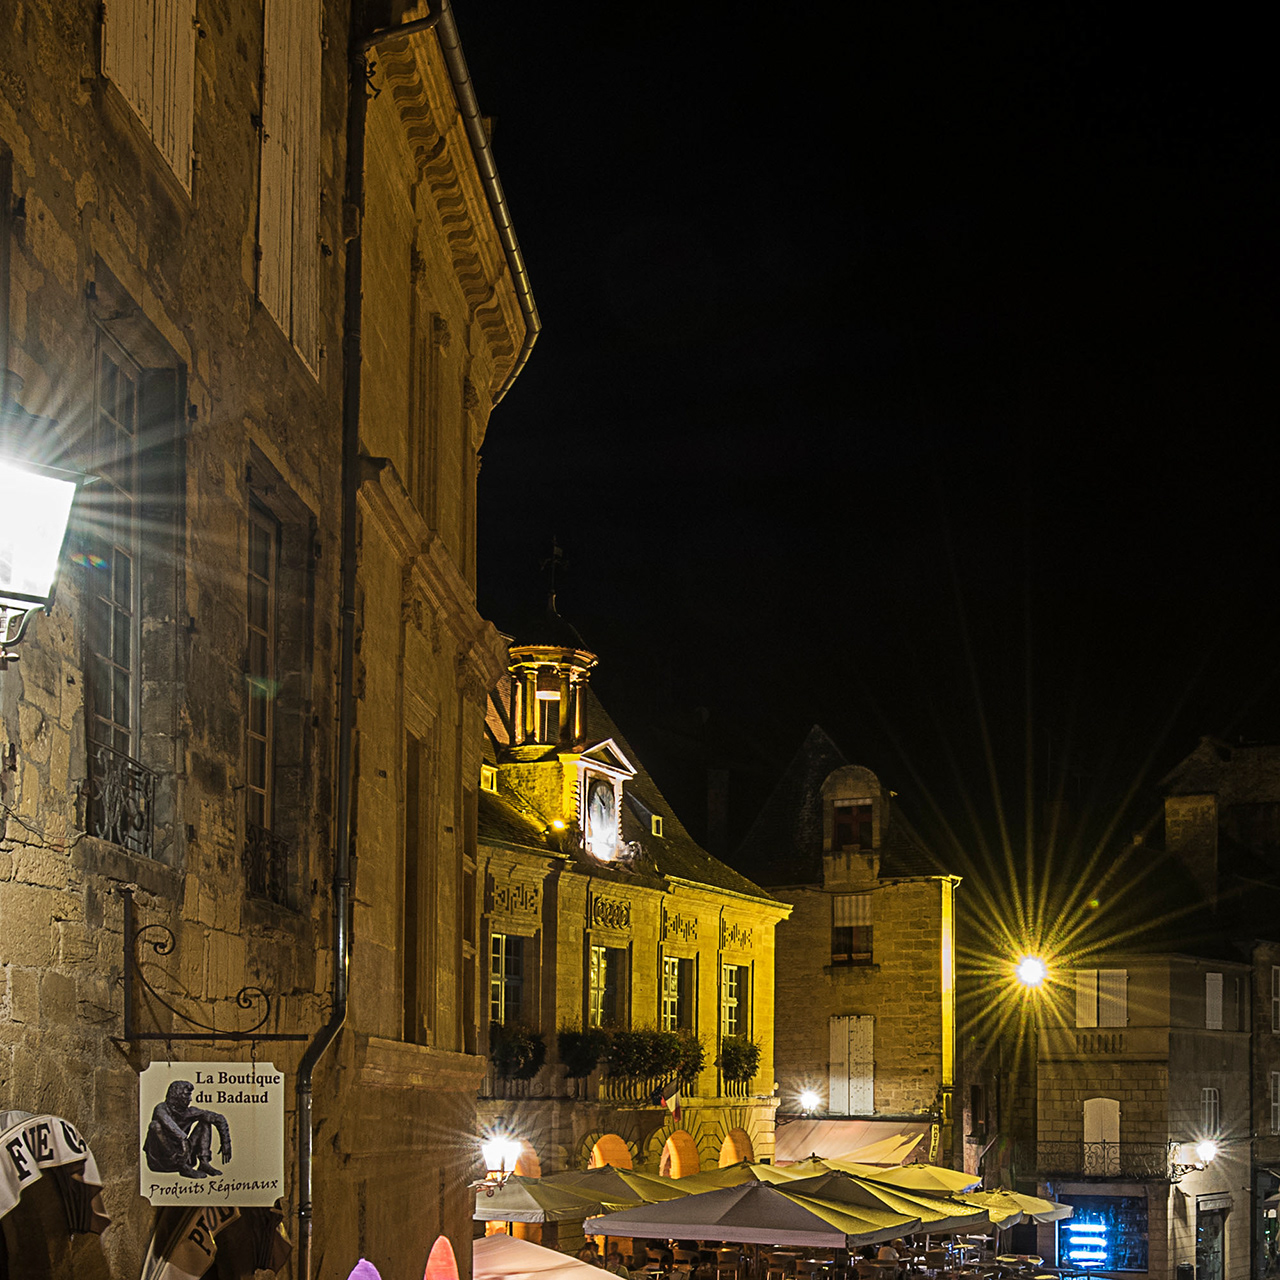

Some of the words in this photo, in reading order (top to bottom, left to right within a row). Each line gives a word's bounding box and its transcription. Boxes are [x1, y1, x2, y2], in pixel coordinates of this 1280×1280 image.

[195, 1071, 214, 1084] La
[218, 1071, 281, 1087] Boutique
[195, 1091, 213, 1104] du
[216, 1091, 269, 1104] Badaud
[930, 1125, 938, 1158] HOTEL
[149, 1182, 205, 1198] Produits
[207, 1179, 278, 1199] Régionaux
